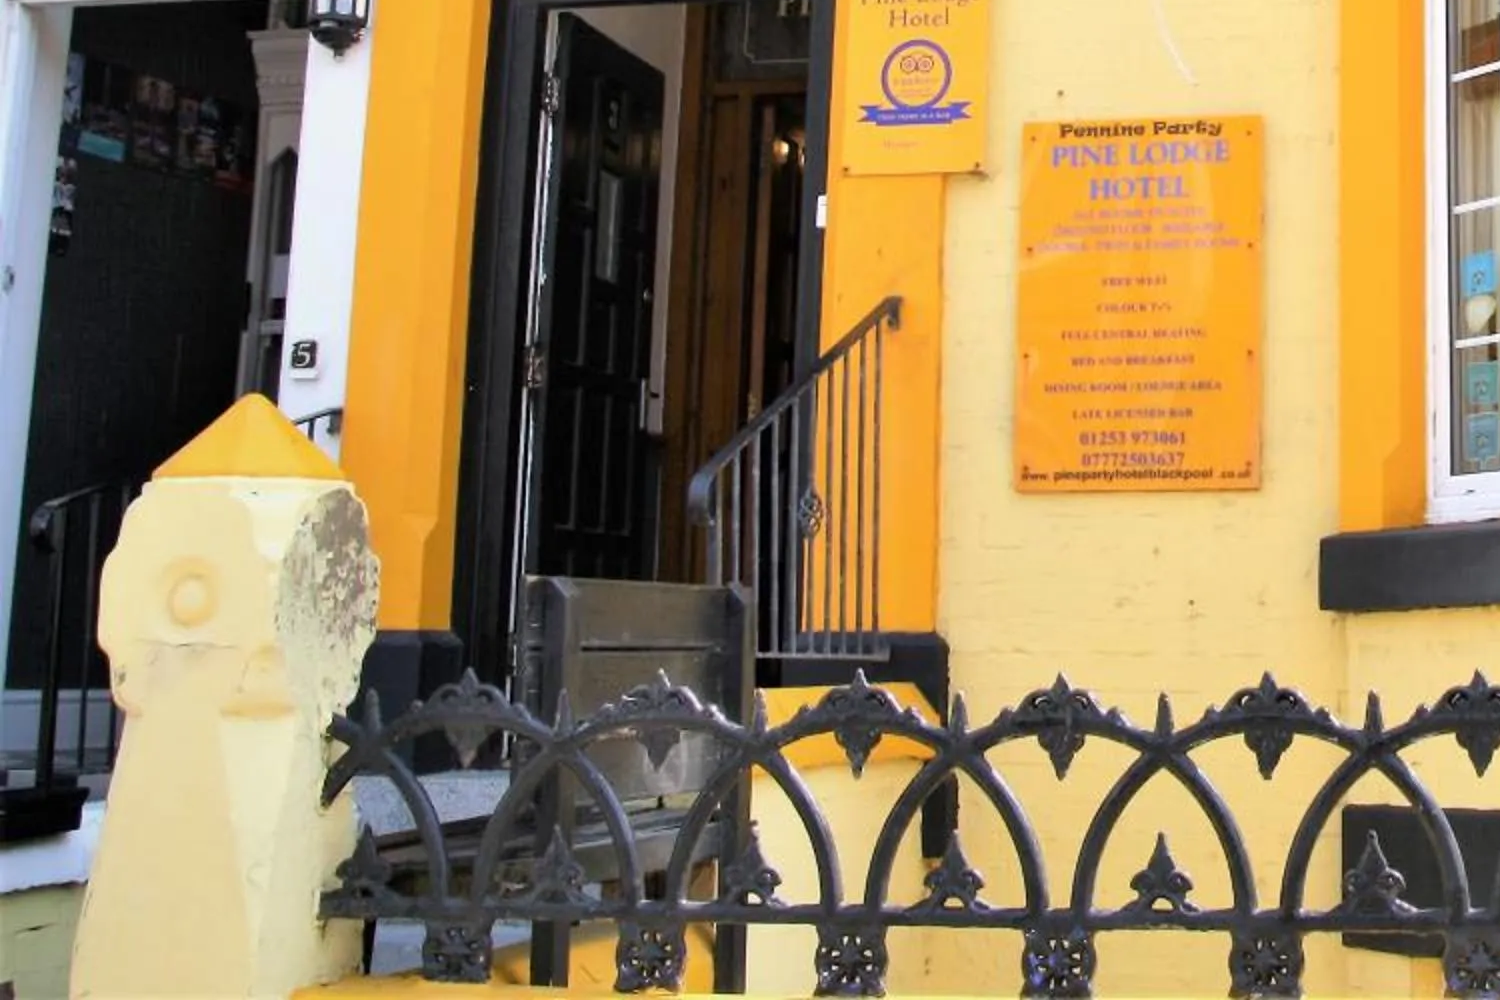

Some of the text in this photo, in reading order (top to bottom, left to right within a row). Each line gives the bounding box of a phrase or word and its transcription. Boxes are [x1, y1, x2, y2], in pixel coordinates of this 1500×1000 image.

[889, 7, 950, 28] Hotel
[1059, 120, 1223, 139] Pennine Party
[1052, 139, 1230, 168] PINE LODGE
[1089, 175, 1189, 200] HOTEL
[295, 343, 311, 367] 5
[1079, 430, 1185, 446] 01253 973061
